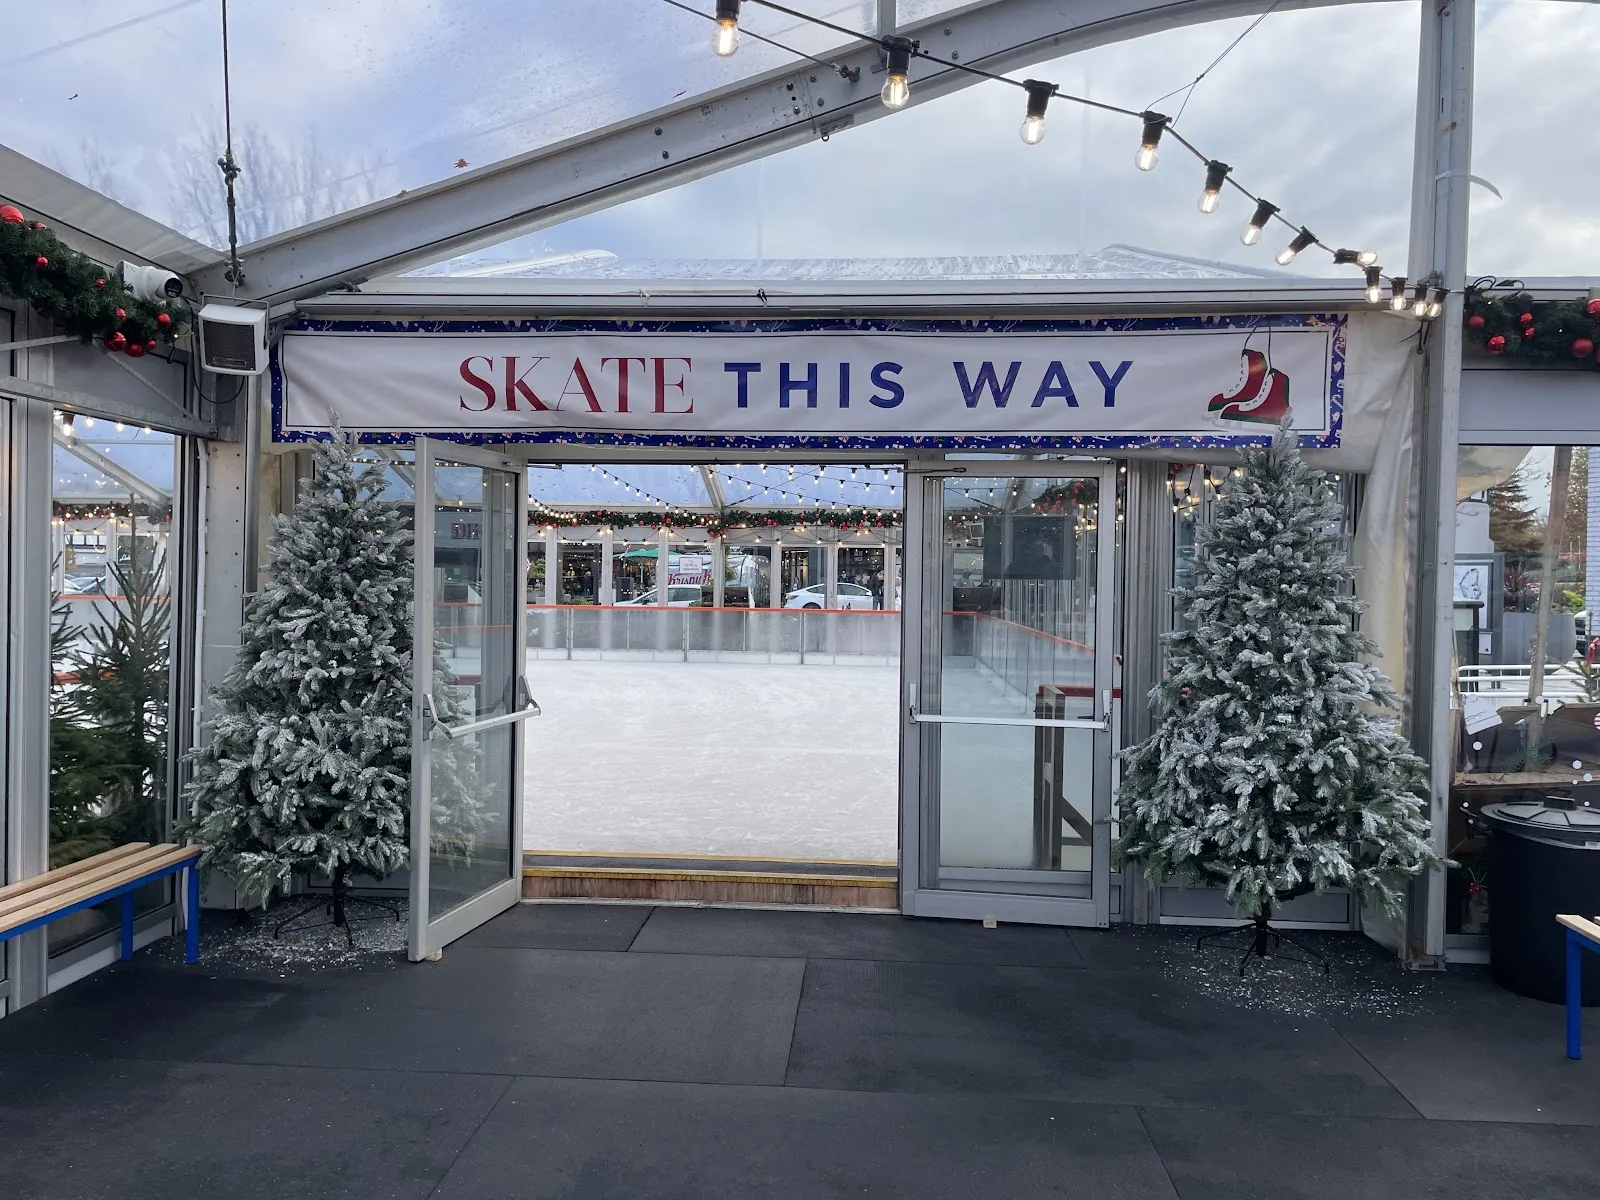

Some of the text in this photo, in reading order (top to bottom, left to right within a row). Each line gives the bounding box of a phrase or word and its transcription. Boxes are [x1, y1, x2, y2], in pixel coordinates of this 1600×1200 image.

[459, 356, 1133, 414] SKATE THIS WAY
